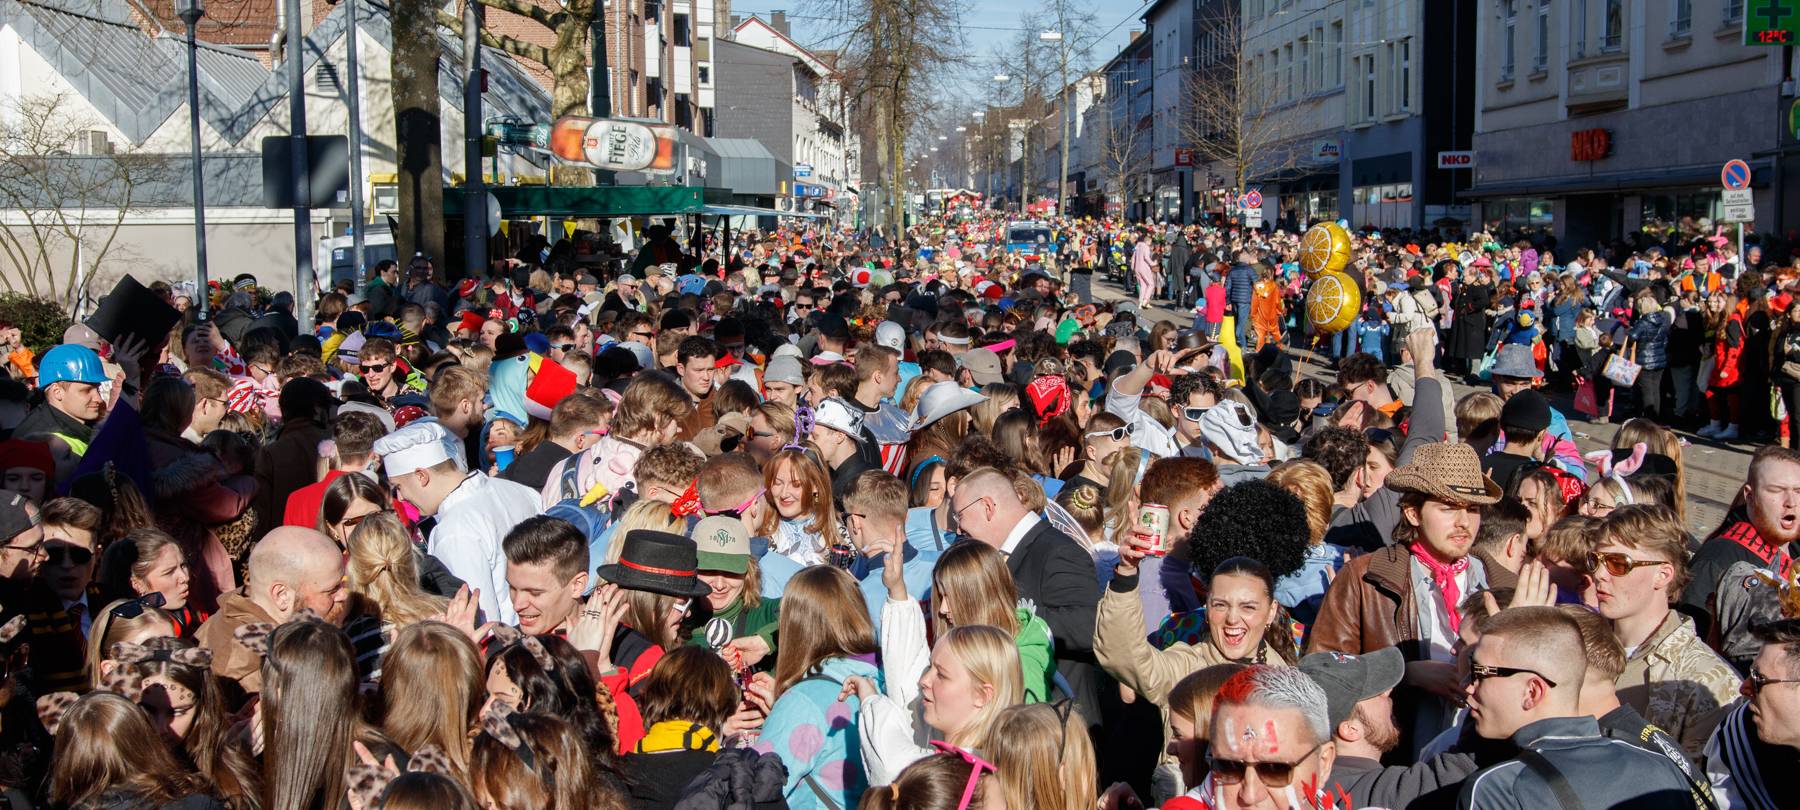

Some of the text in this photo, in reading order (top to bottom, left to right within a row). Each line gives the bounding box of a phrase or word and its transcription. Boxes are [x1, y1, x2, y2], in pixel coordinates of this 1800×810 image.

[608, 125, 627, 165] FIEGE
[1321, 142, 1338, 153] dm
[1571, 128, 1609, 161] NKD
[1441, 154, 1471, 166] NKD
